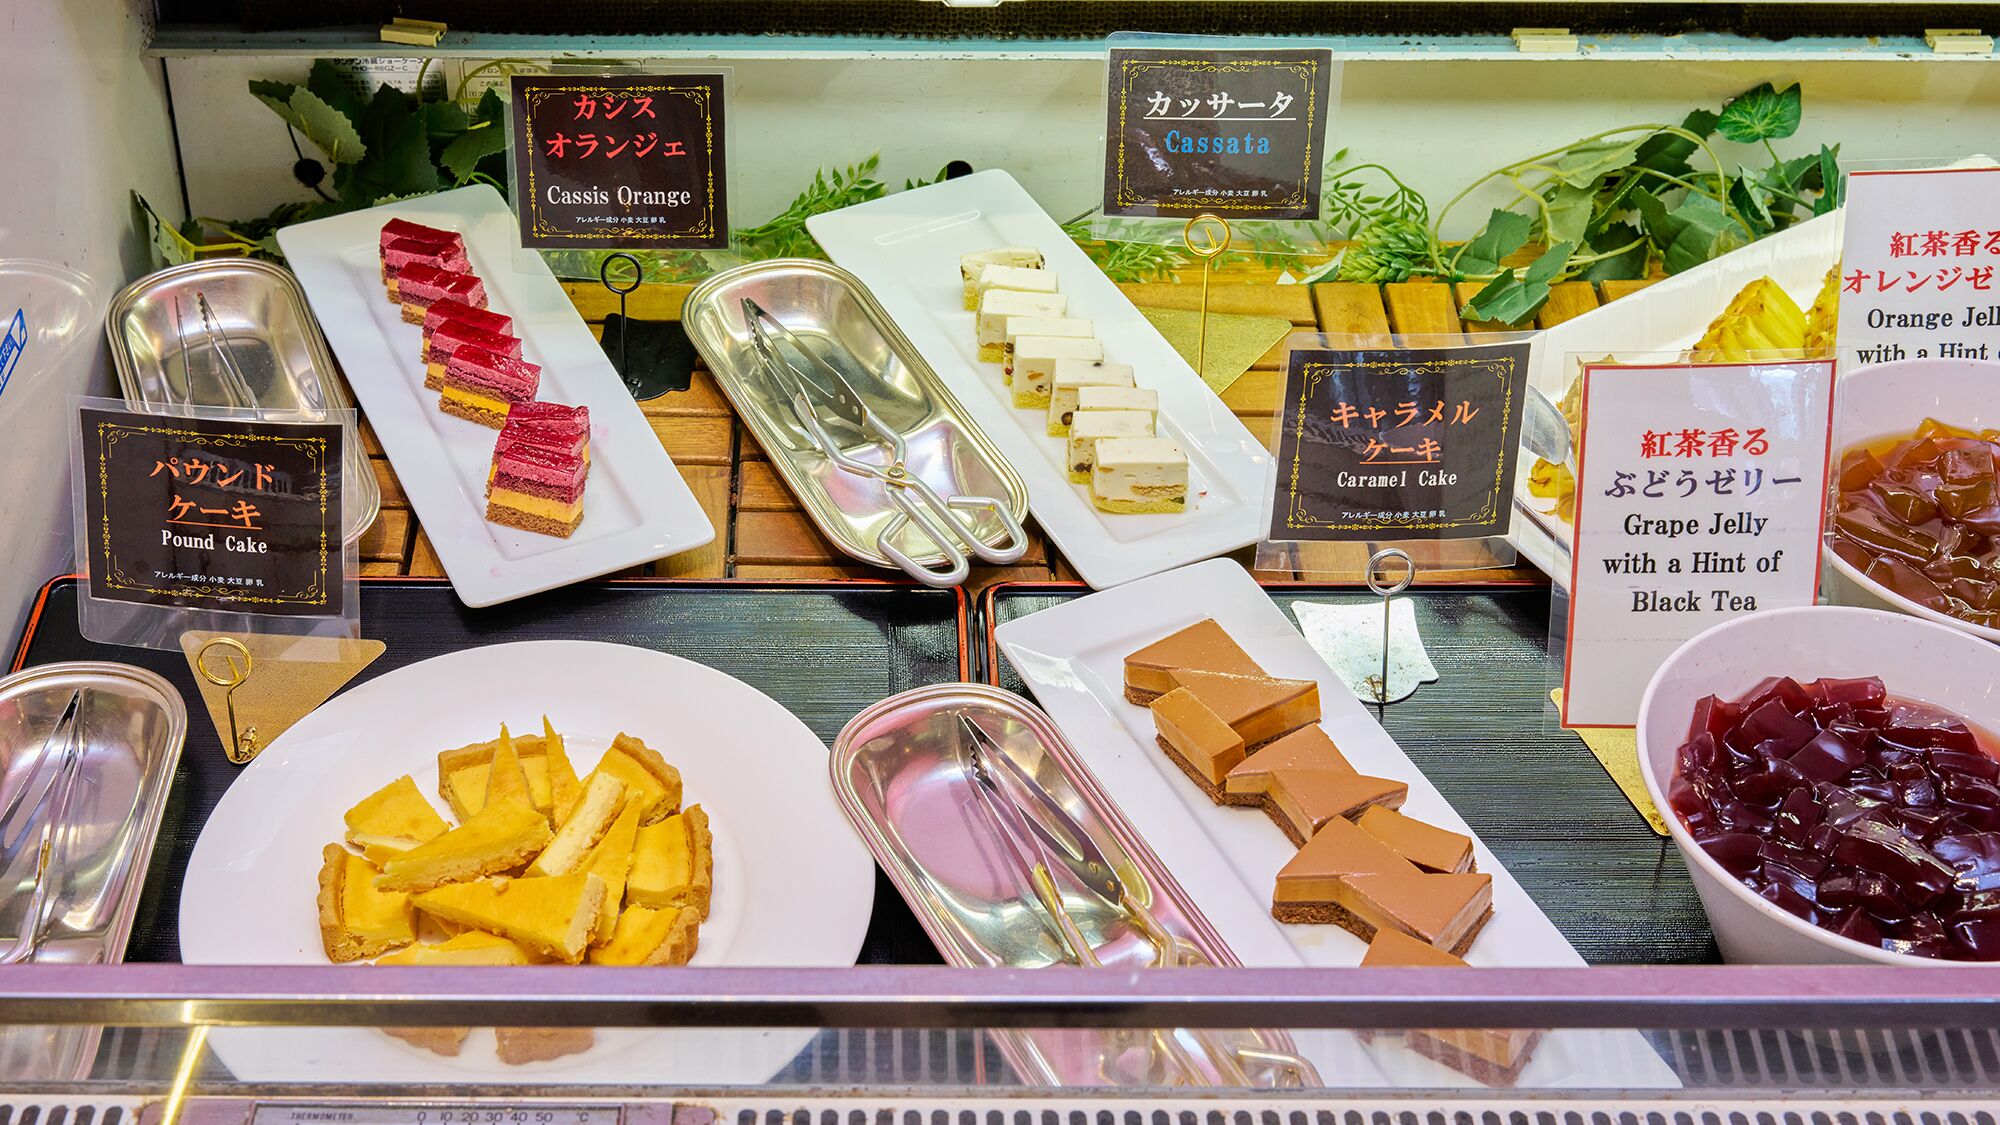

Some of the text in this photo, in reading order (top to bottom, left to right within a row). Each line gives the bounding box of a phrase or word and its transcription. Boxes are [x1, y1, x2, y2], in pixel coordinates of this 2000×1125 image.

[573, 94, 656, 120] カシス
[1146, 91, 1294, 118] カッサータ
[545, 132, 686, 160] オランジェ
[1165, 129, 1271, 154] Cassata
[547, 185, 691, 208] Cassis Orange
[1867, 308, 1953, 330] Orange
[1857, 343, 1905, 364] with
[1940, 342, 1988, 360] Hint
[1331, 400, 1480, 429] キャラメル
[1362, 437, 1442, 462] ケーキ
[1640, 427, 1770, 459] 紅茶香る
[150, 457, 276, 490] パウンド
[1337, 470, 1457, 488] Caramel Cake
[1604, 468, 1802, 498] ぶどうゼリー
[168, 495, 261, 527] ケーキ
[1623, 512, 1768, 538] Grape Jelly
[161, 529, 267, 553] Pound Cake
[1602, 550, 1783, 574] with a Hint of
[1631, 590, 1757, 613] Black Tea
[417, 1112, 426, 1122] 0
[440, 1112, 453, 1122] 10
[462, 1112, 479, 1122] 20
[485, 1112, 502, 1122] 30
[510, 1112, 527, 1122] 40
[536, 1112, 553, 1122] 50
